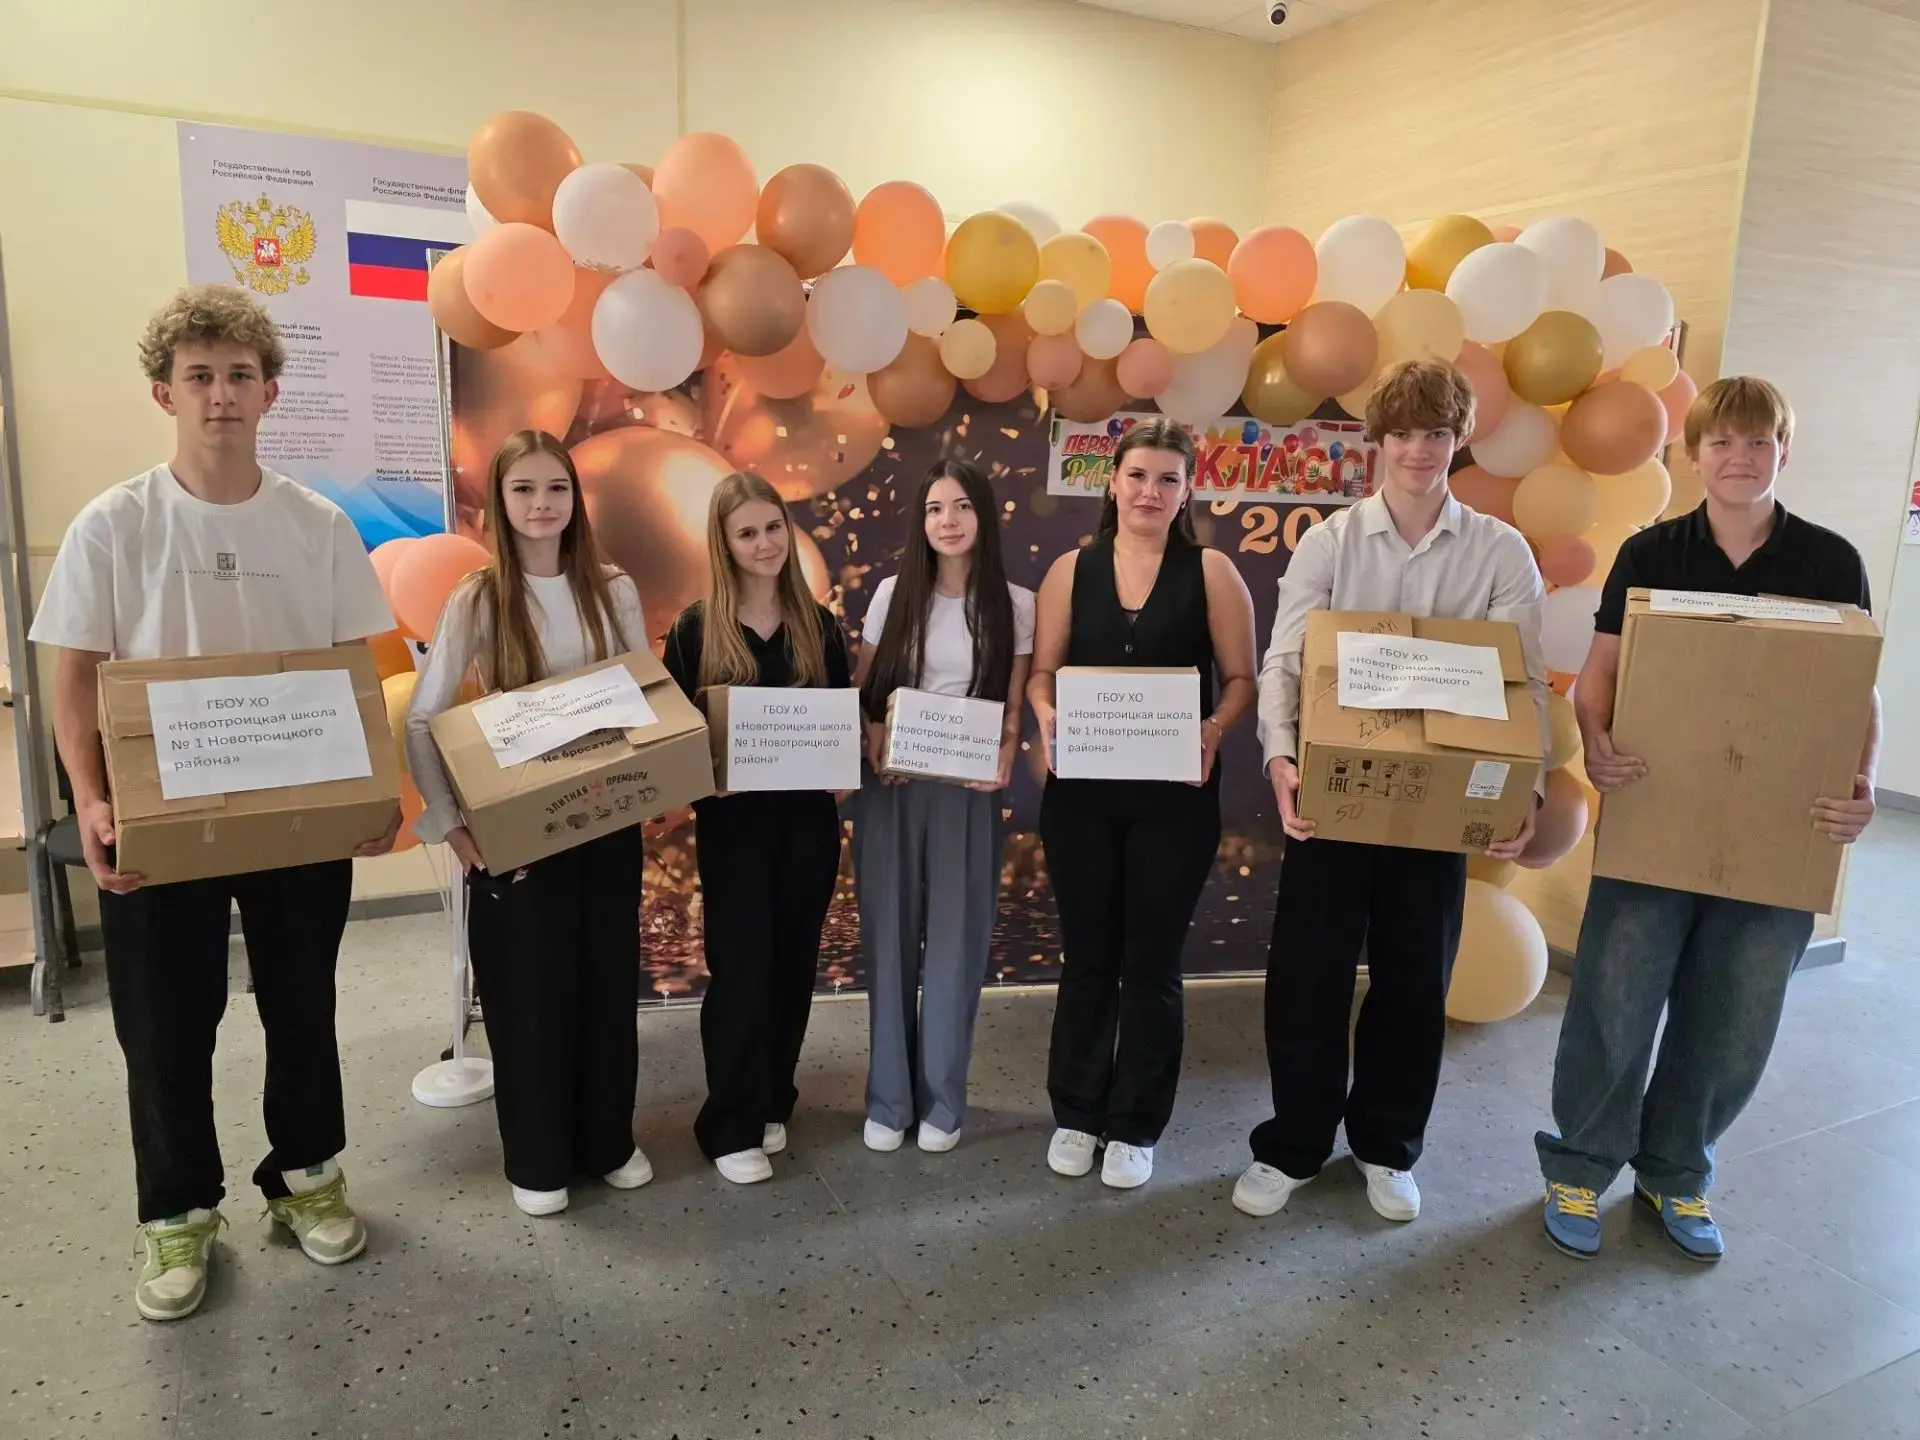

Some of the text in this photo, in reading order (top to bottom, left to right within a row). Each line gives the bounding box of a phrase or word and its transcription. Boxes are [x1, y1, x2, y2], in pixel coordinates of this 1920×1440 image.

[213, 159, 312, 177] Государственный герб
[212, 168, 314, 186] Российской Федерации
[372, 177, 446, 192] Государственный
[372, 186, 422, 198] Российской
[299, 324, 321, 332] гимн
[280, 332, 322, 341] едерации
[1379, 647, 1429, 662] ГБОУ ХО
[1349, 656, 1483, 675] «Новотроицкая школа
[1349, 667, 1470, 686] № 1 Новотроицкого
[206, 696, 270, 710] ГБОУ ХО
[550, 692, 566, 701] ХО
[1097, 692, 1144, 703] ГБОУ ХО
[763, 704, 808, 715] ГБОУ ХО
[1068, 709, 1193, 721] «Новотроицкая школа
[168, 708, 337, 732] «Новотроицкая школа
[920, 710, 964, 725] ГБОУ ХО
[735, 721, 852, 732] «Новотроицкая школа
[1068, 726, 1179, 738] № 1 Новотроицкого
[171, 726, 324, 751] № 1 Новотроицкого
[895, 723, 1000, 747] Новотроицкая школ
[734, 738, 840, 750] № 1 Новотроицкого
[1068, 742, 1114, 754] района»
[903, 741, 909, 750] 1
[912, 742, 991, 762] Новотроицкого
[174, 754, 240, 772] района»
[541, 754, 560, 765] Не
[734, 754, 780, 766] района»
[891, 755, 929, 769] айона»
[605, 771, 648, 787] ПРЕМЬЕРА
